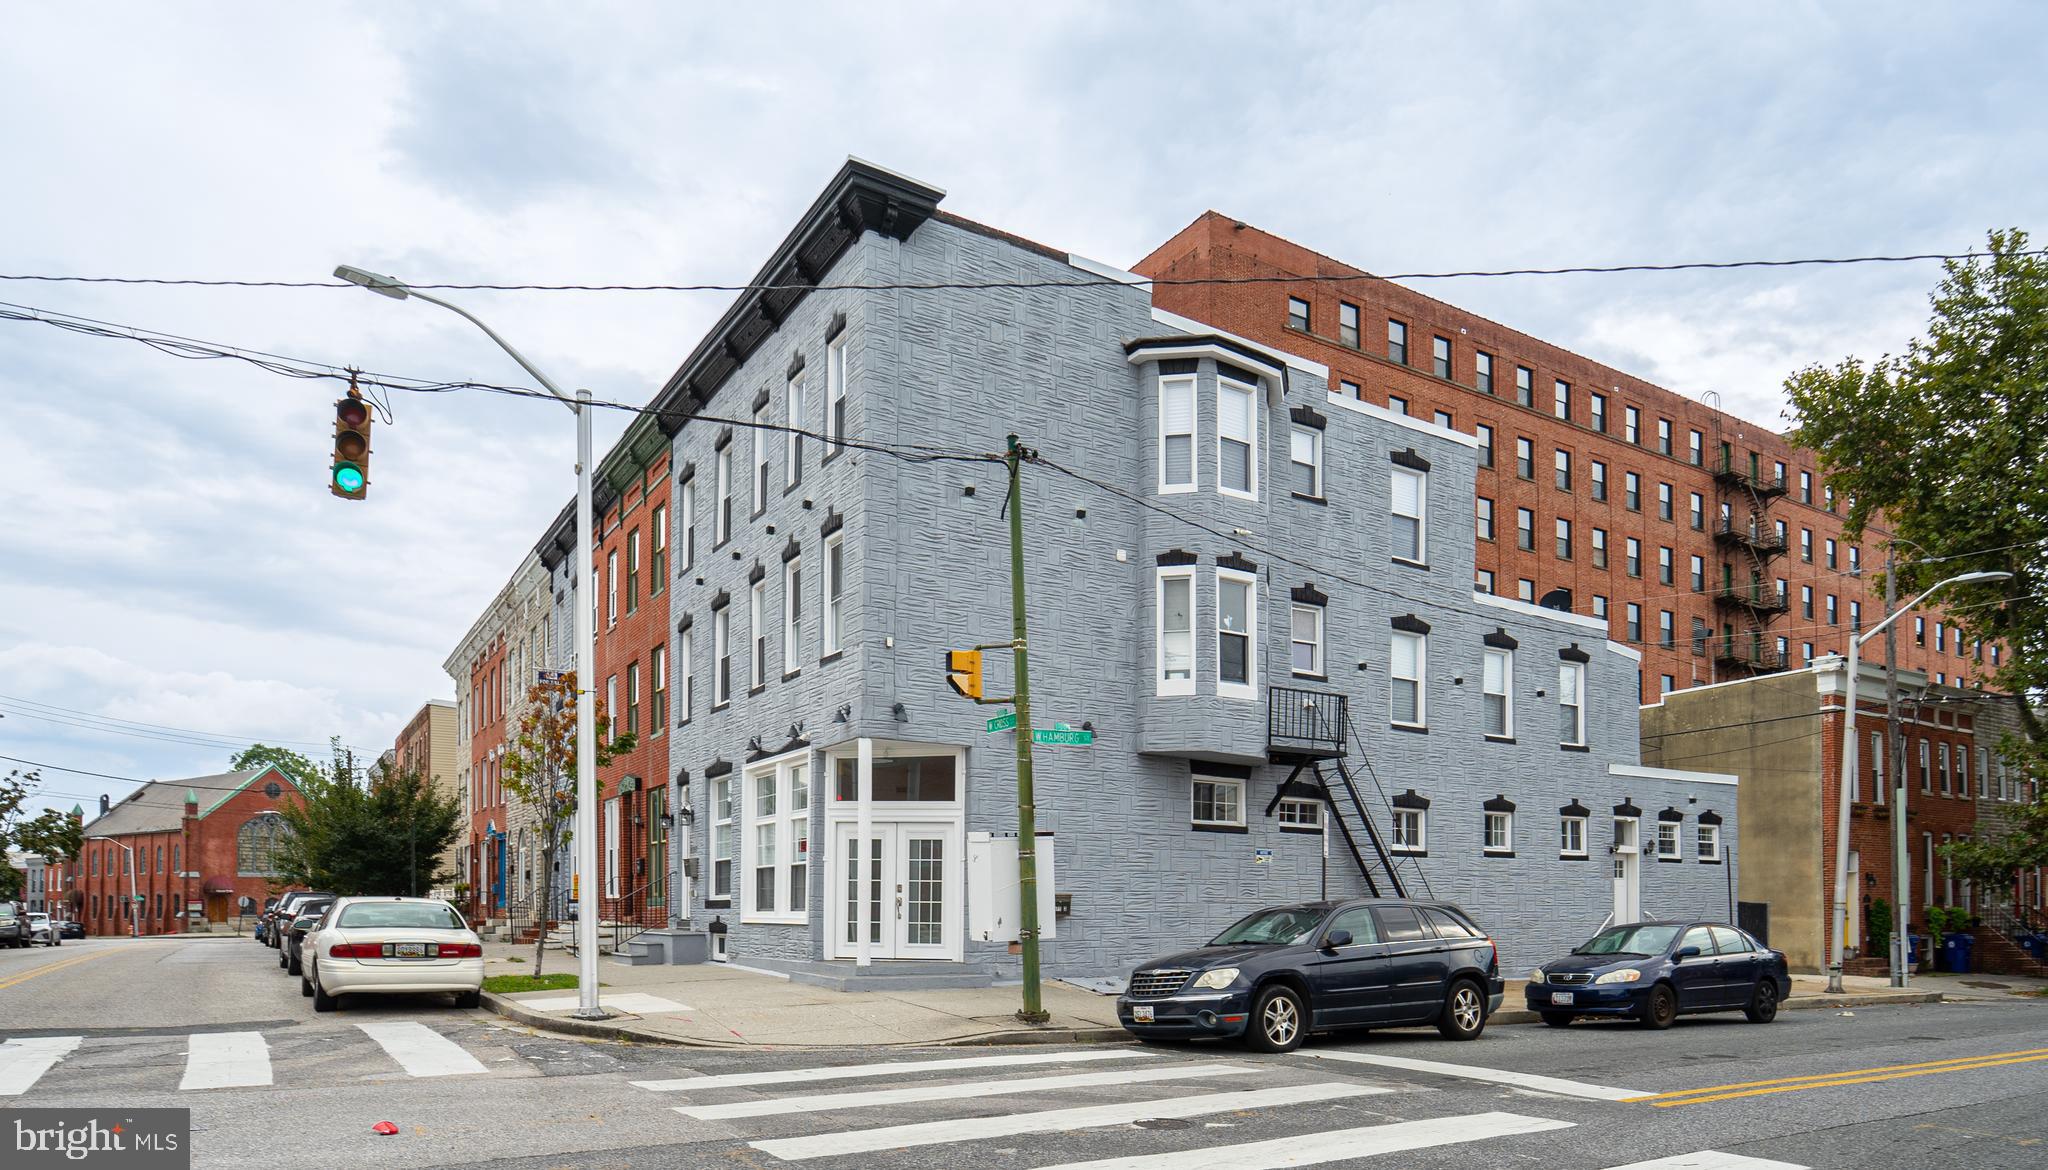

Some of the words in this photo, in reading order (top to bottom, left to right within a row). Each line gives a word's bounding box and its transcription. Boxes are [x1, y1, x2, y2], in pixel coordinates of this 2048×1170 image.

[994, 717, 1010, 730] CROSS
[1035, 732, 1042, 741] W
[1042, 731, 1080, 743] HAMBURG
